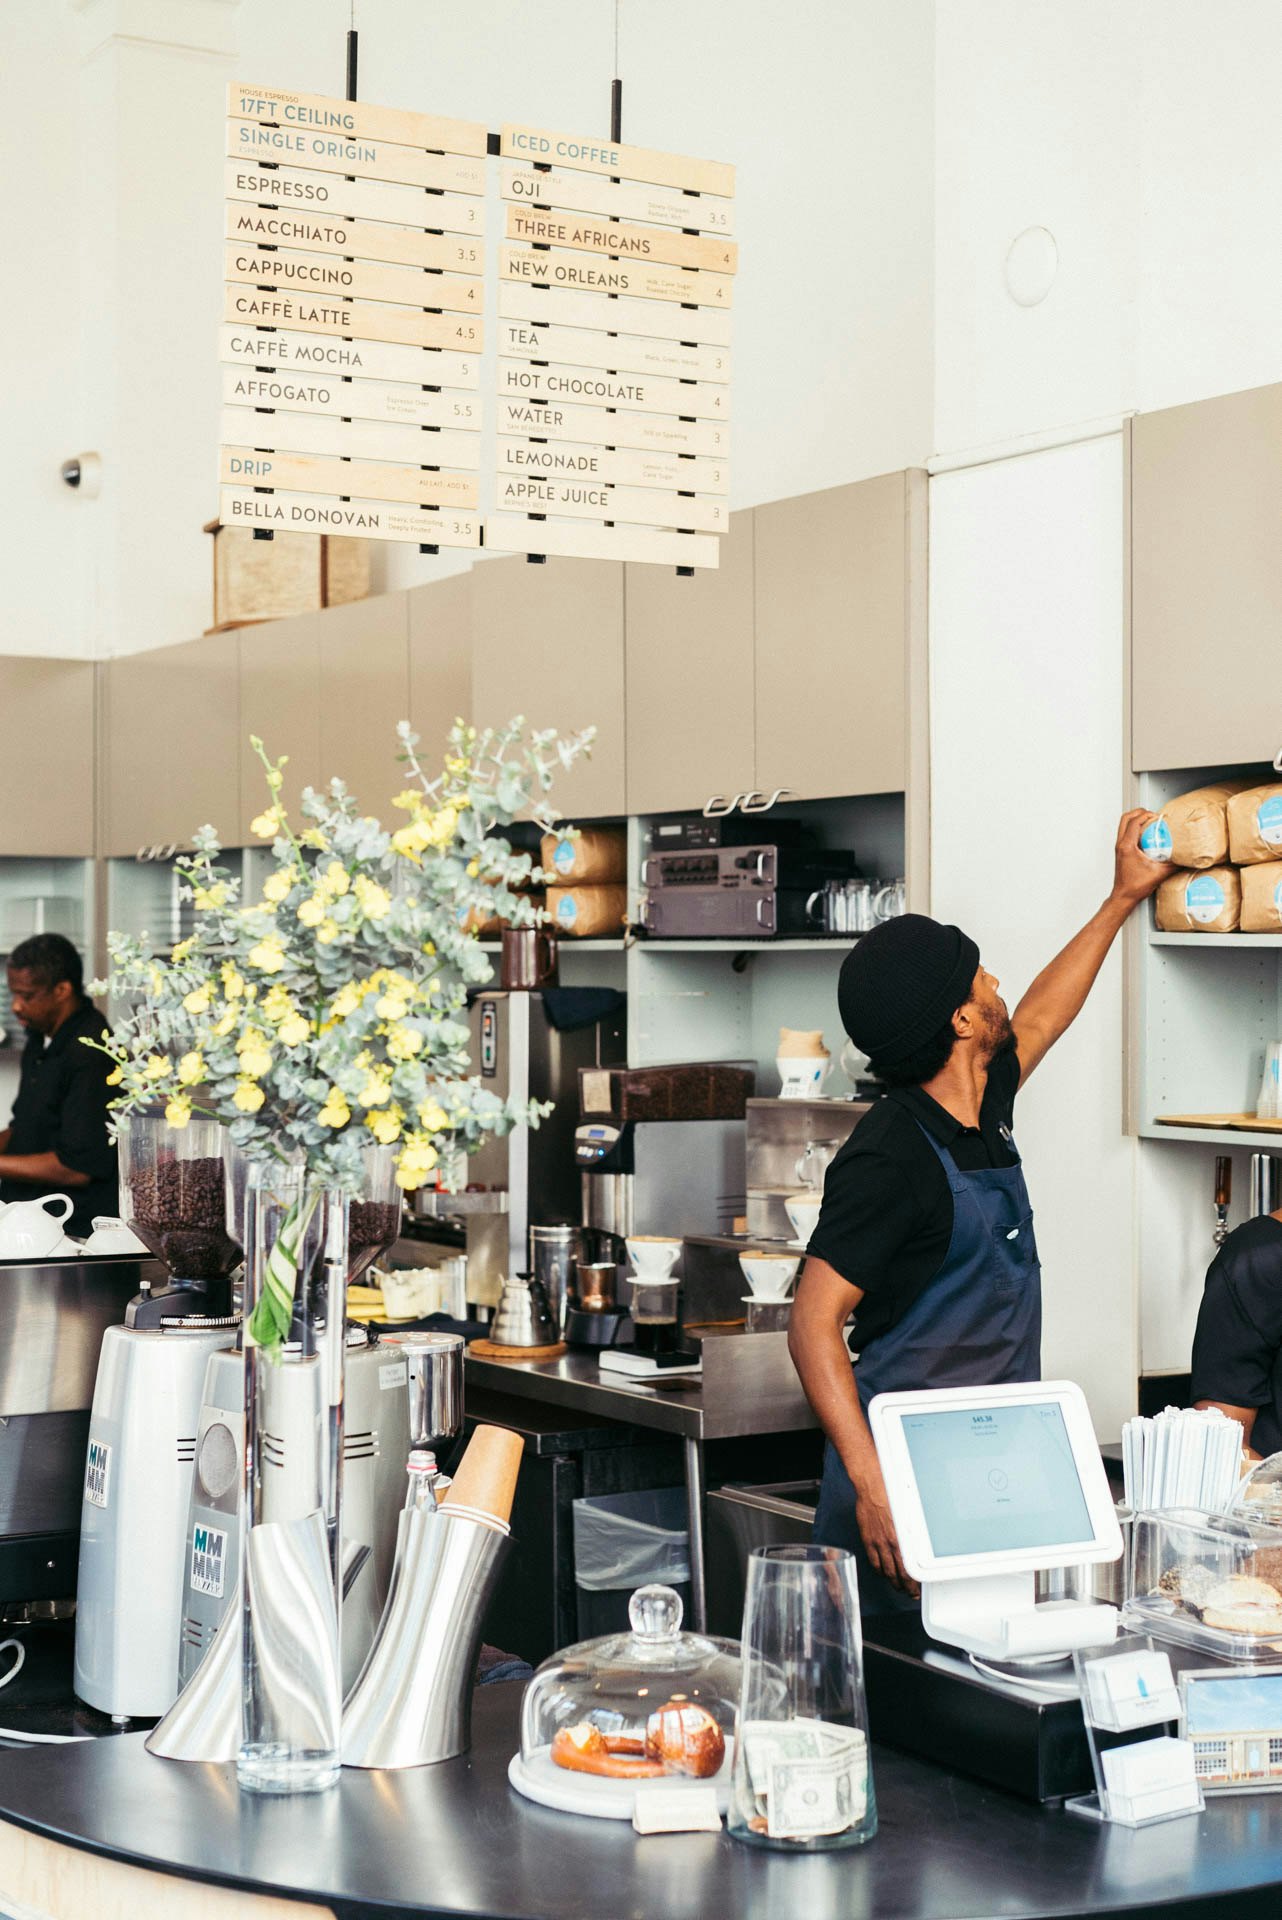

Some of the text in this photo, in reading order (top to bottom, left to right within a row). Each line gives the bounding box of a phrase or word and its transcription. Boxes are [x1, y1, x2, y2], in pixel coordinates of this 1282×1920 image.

[240, 87, 299, 103] HOUSE ESPRESSO
[240, 98, 355, 130] 17FT CEILING
[240, 127, 377, 163] SINGLE ORIGIN
[512, 133, 619, 166] ICED COFFEE
[236, 174, 329, 202] ESPRESSO
[512, 180, 540, 198] OJI
[468, 209, 475, 221] 3
[709, 212, 727, 225] 3.5
[237, 216, 347, 245] MACCHIATO
[515, 218, 651, 254] THREE AFRICANS
[457, 248, 476, 261] 3.5
[723, 254, 730, 264] 4
[235, 257, 353, 286] CAPPUCCINO
[509, 261, 630, 289] NEW ORLEANS
[467, 289, 475, 300] 4
[716, 288, 723, 298] 4
[235, 298, 351, 326] CAFFÈ LATTE
[456, 326, 475, 340] 4.5
[509, 328, 539, 346] TEA
[230, 337, 363, 367] CAFFÈ MOCHA
[461, 364, 469, 376] 5
[715, 358, 722, 369] 3
[234, 380, 331, 404] AFFOGATO
[507, 371, 645, 401] HOT CHOCOLATE
[453, 404, 473, 417] 5.5
[714, 396, 721, 407] 4
[507, 405, 564, 426] WATER
[714, 432, 721, 444] 3
[230, 459, 273, 476] DRIP
[507, 449, 599, 473] LEMONADE
[713, 470, 720, 482] 3
[505, 483, 609, 506] APPLE JUICE
[231, 501, 380, 528] BELLA DONOVAN
[713, 507, 720, 519] 3
[453, 521, 472, 535] 3.5
